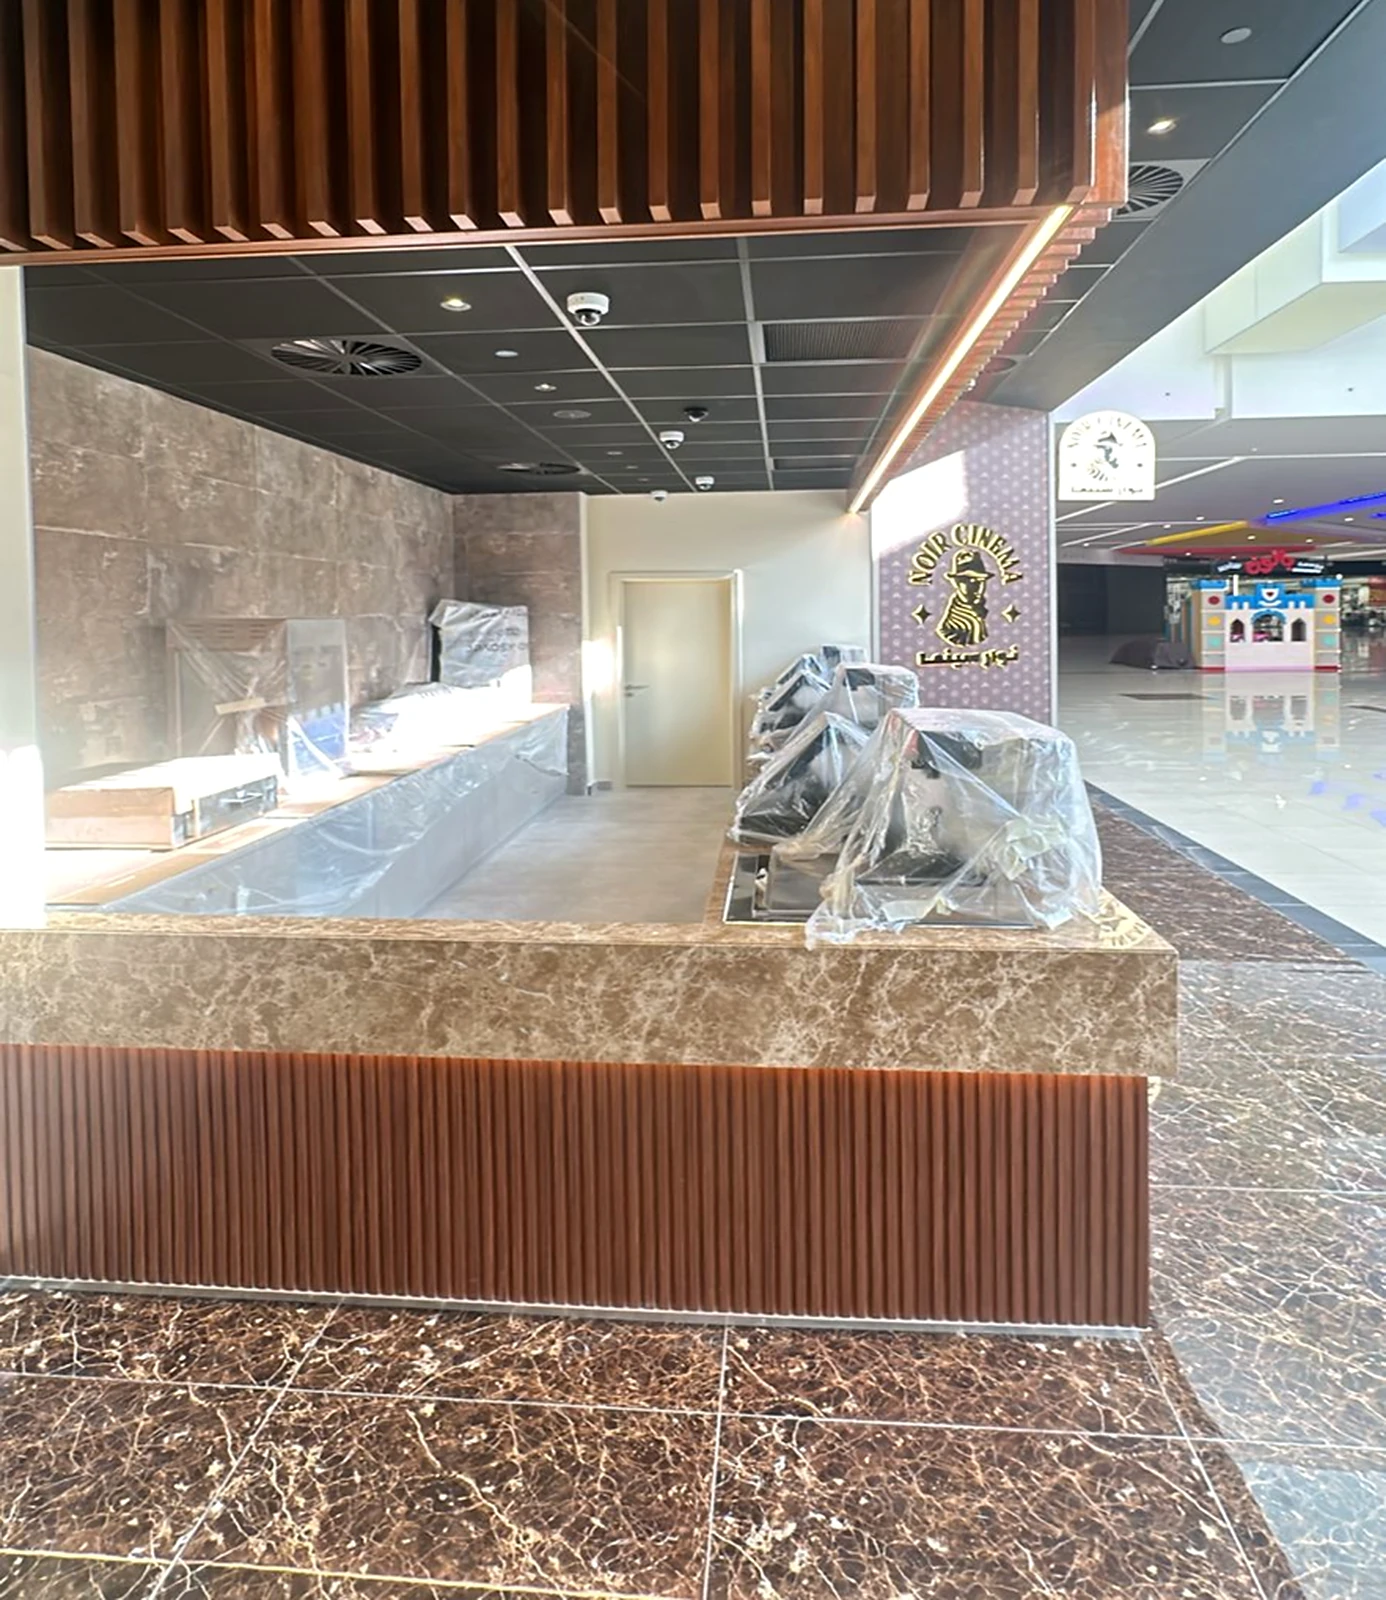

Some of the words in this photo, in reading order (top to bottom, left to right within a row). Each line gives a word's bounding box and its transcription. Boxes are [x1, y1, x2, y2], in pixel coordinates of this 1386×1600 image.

[908, 531, 952, 586] NOIR
[951, 523, 1023, 586] CINEMA
[916, 647, 981, 670] سينما
